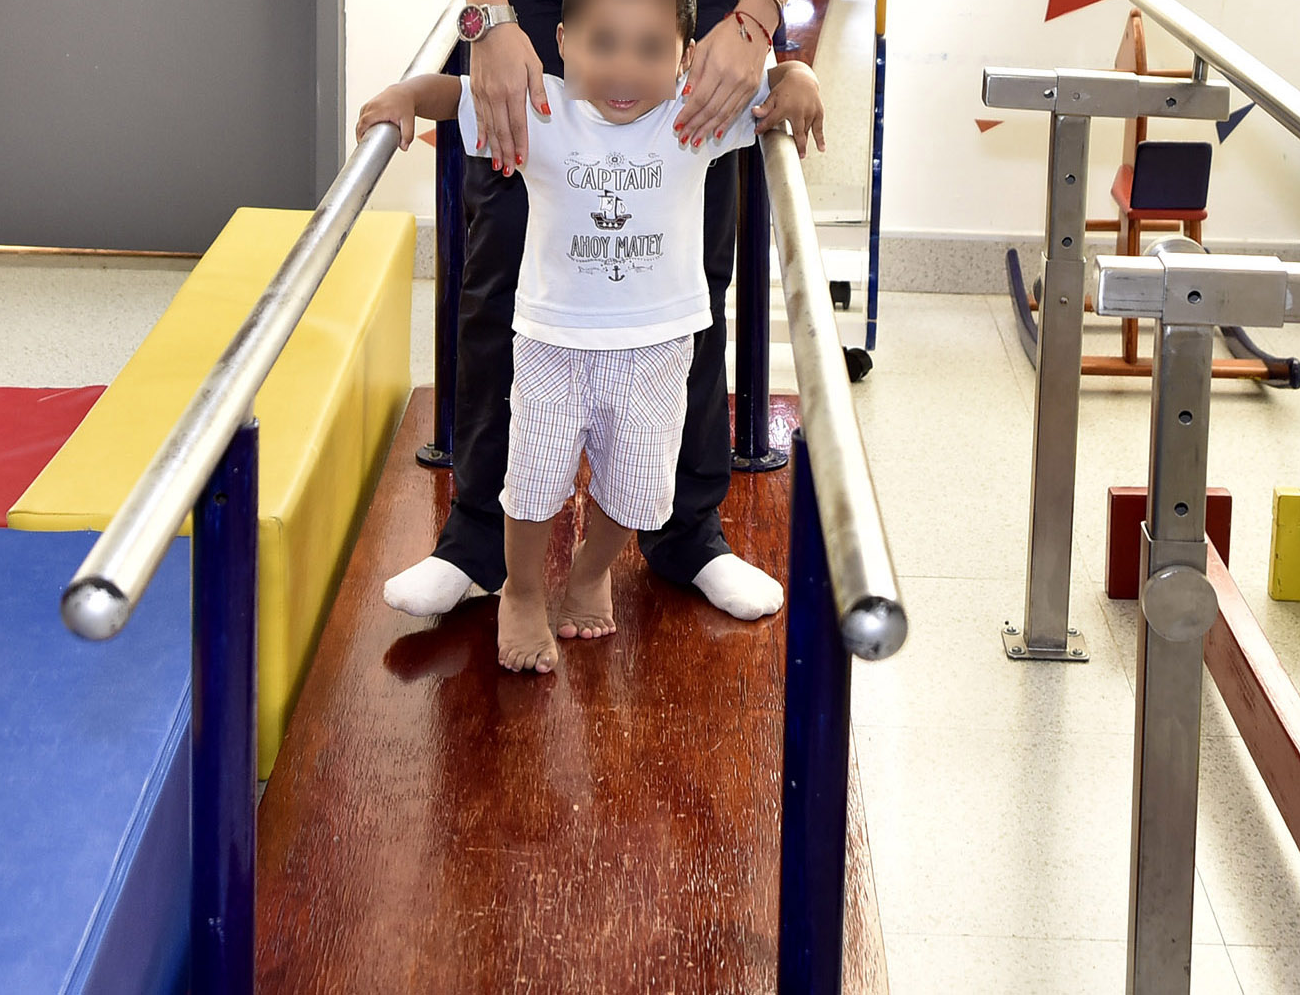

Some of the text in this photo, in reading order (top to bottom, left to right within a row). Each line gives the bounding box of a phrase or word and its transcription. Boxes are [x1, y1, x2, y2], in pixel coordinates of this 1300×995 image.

[566, 165, 662, 191] CAPTAIN
[570, 233, 664, 258] AHOY MATEY
